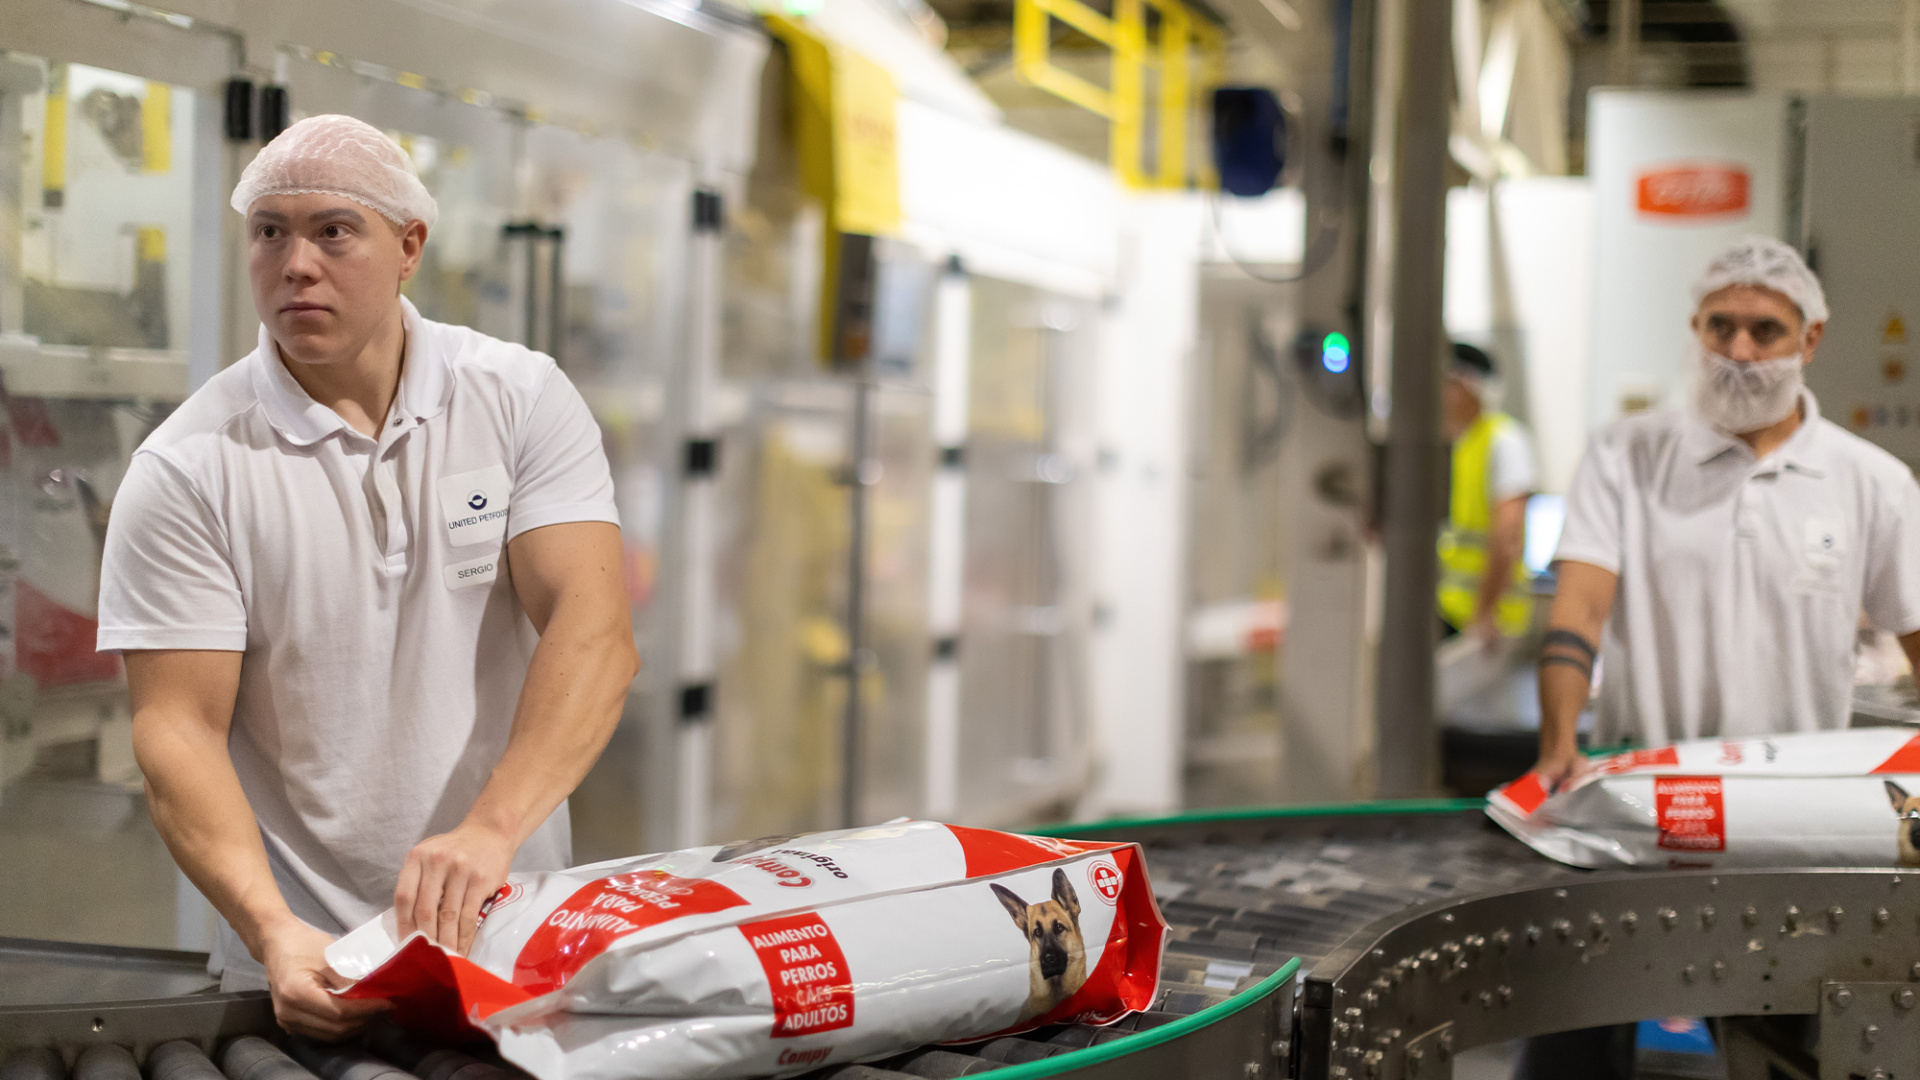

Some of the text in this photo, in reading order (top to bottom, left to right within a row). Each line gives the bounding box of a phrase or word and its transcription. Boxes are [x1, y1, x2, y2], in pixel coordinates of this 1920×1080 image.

[449, 517, 477, 529] UNITED
[458, 564, 493, 579] SERGIO
[592, 892, 644, 913] PARA
[548, 909, 639, 934] ALIMNTO
[752, 924, 828, 949] ALIMENTO
[780, 944, 822, 963] PARA
[780, 961, 837, 986] PERROS
[796, 984, 833, 1006] CÃES
[782, 1004, 847, 1031] ADULTOS
[778, 1046, 835, 1066] Compy
